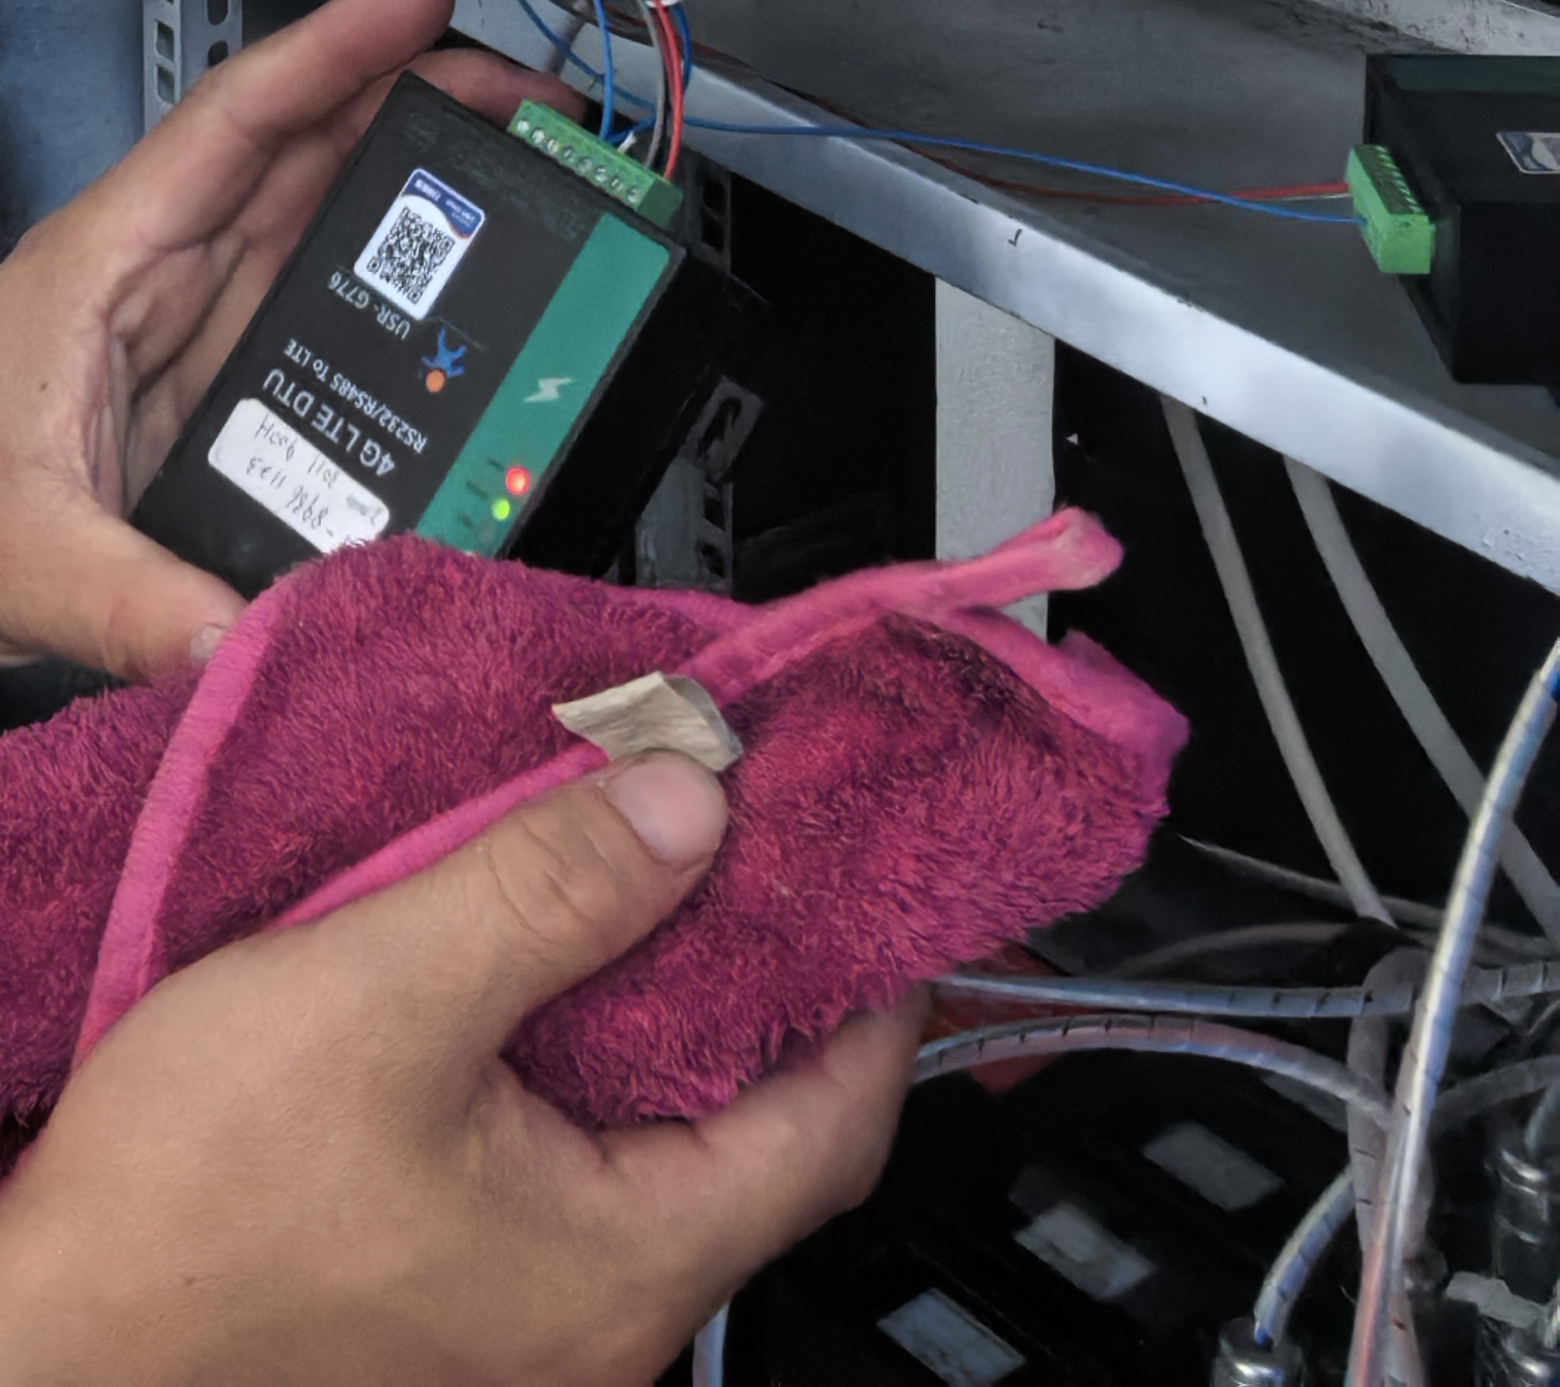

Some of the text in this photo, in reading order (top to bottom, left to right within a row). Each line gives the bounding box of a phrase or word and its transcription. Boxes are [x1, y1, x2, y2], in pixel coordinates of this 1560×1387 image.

[327, 271, 371, 310] G776
[262, 368, 396, 477] 4G LTE DTU
[283, 338, 428, 454] RS232/RS485 To LTE
